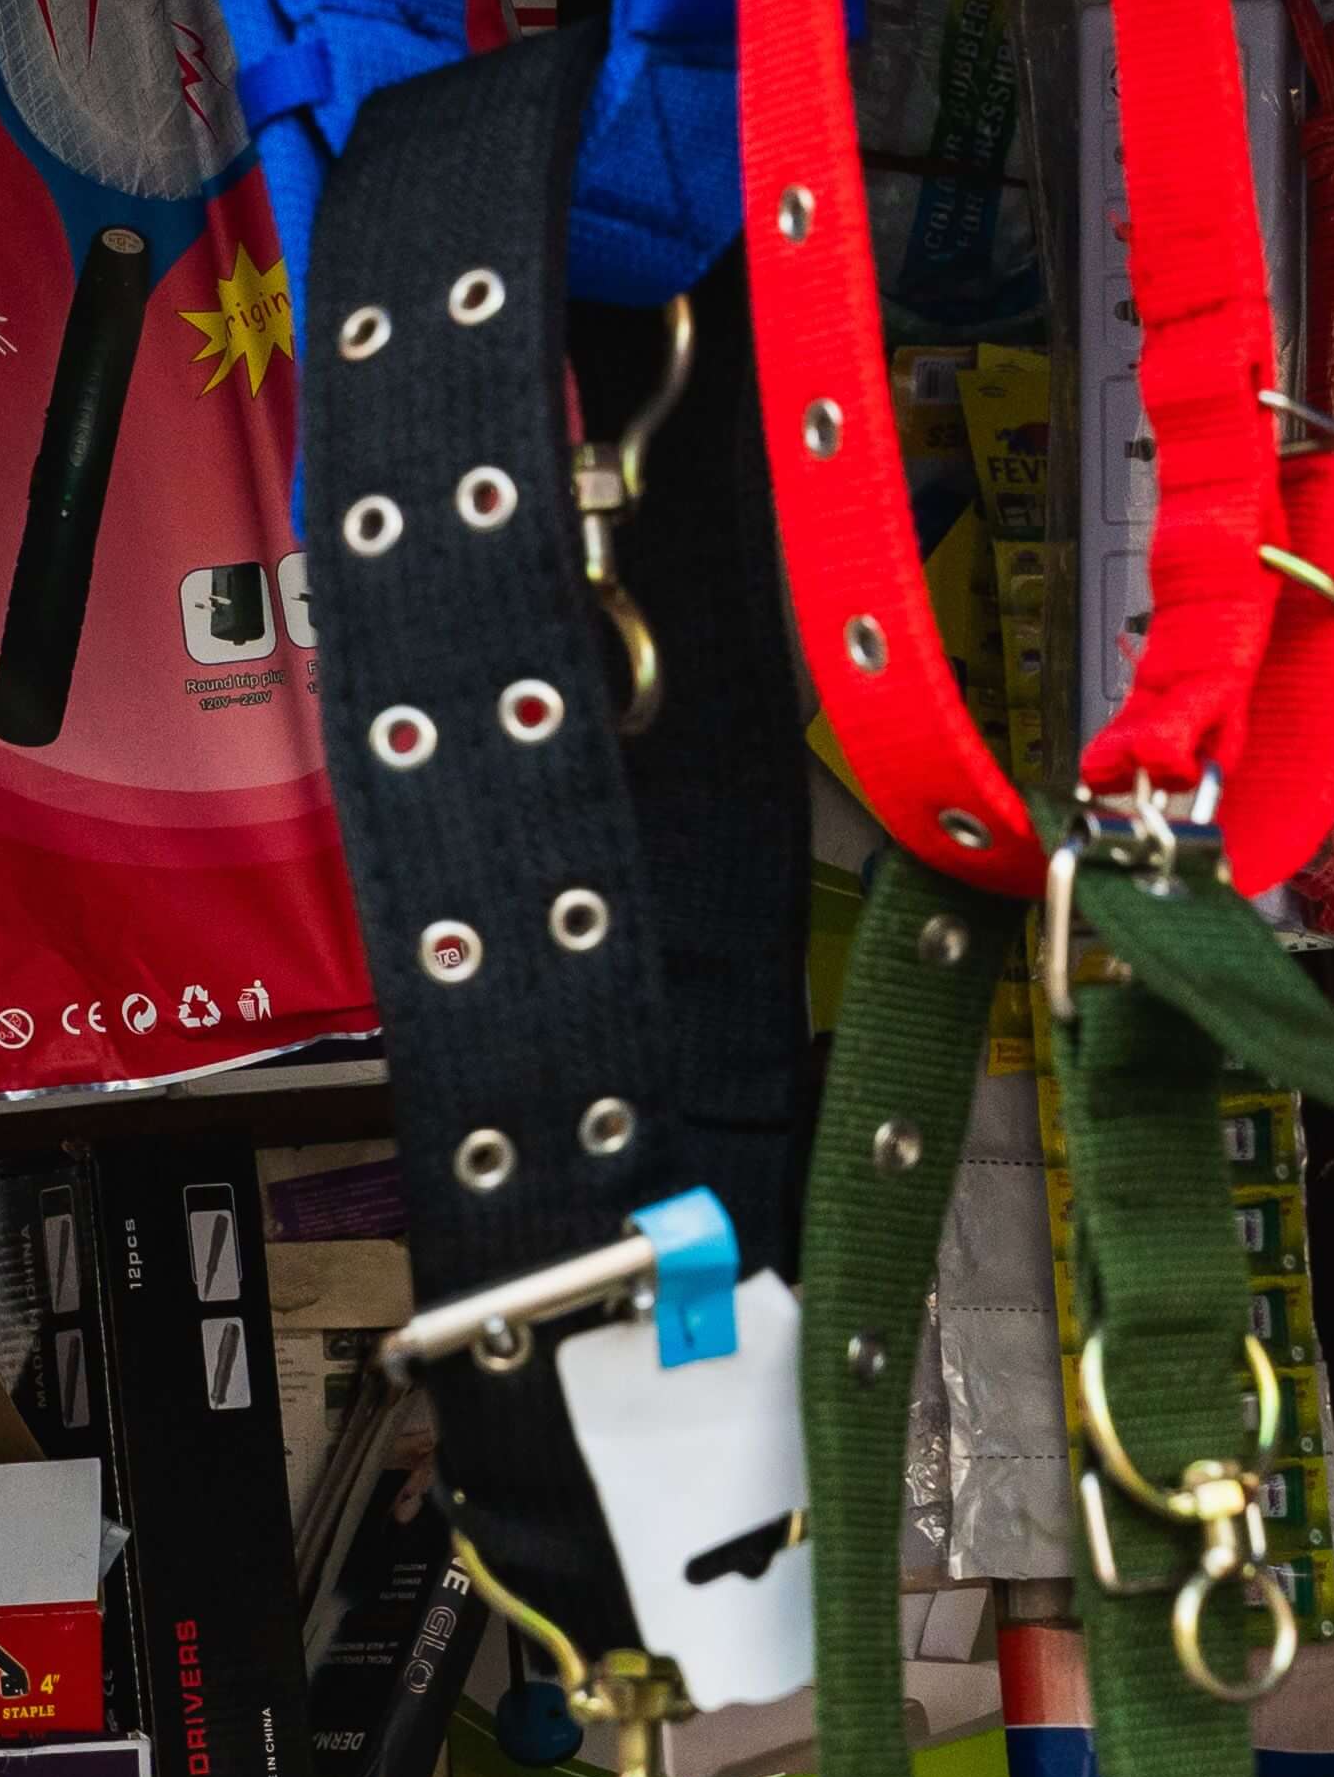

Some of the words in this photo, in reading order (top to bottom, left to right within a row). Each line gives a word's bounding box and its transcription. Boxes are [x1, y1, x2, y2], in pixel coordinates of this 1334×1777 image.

[224, 291, 289, 339] rigin
[186, 675, 234, 695] Round
[235, 674, 259, 694] trip
[2, 1704, 55, 1720] STAPLE
